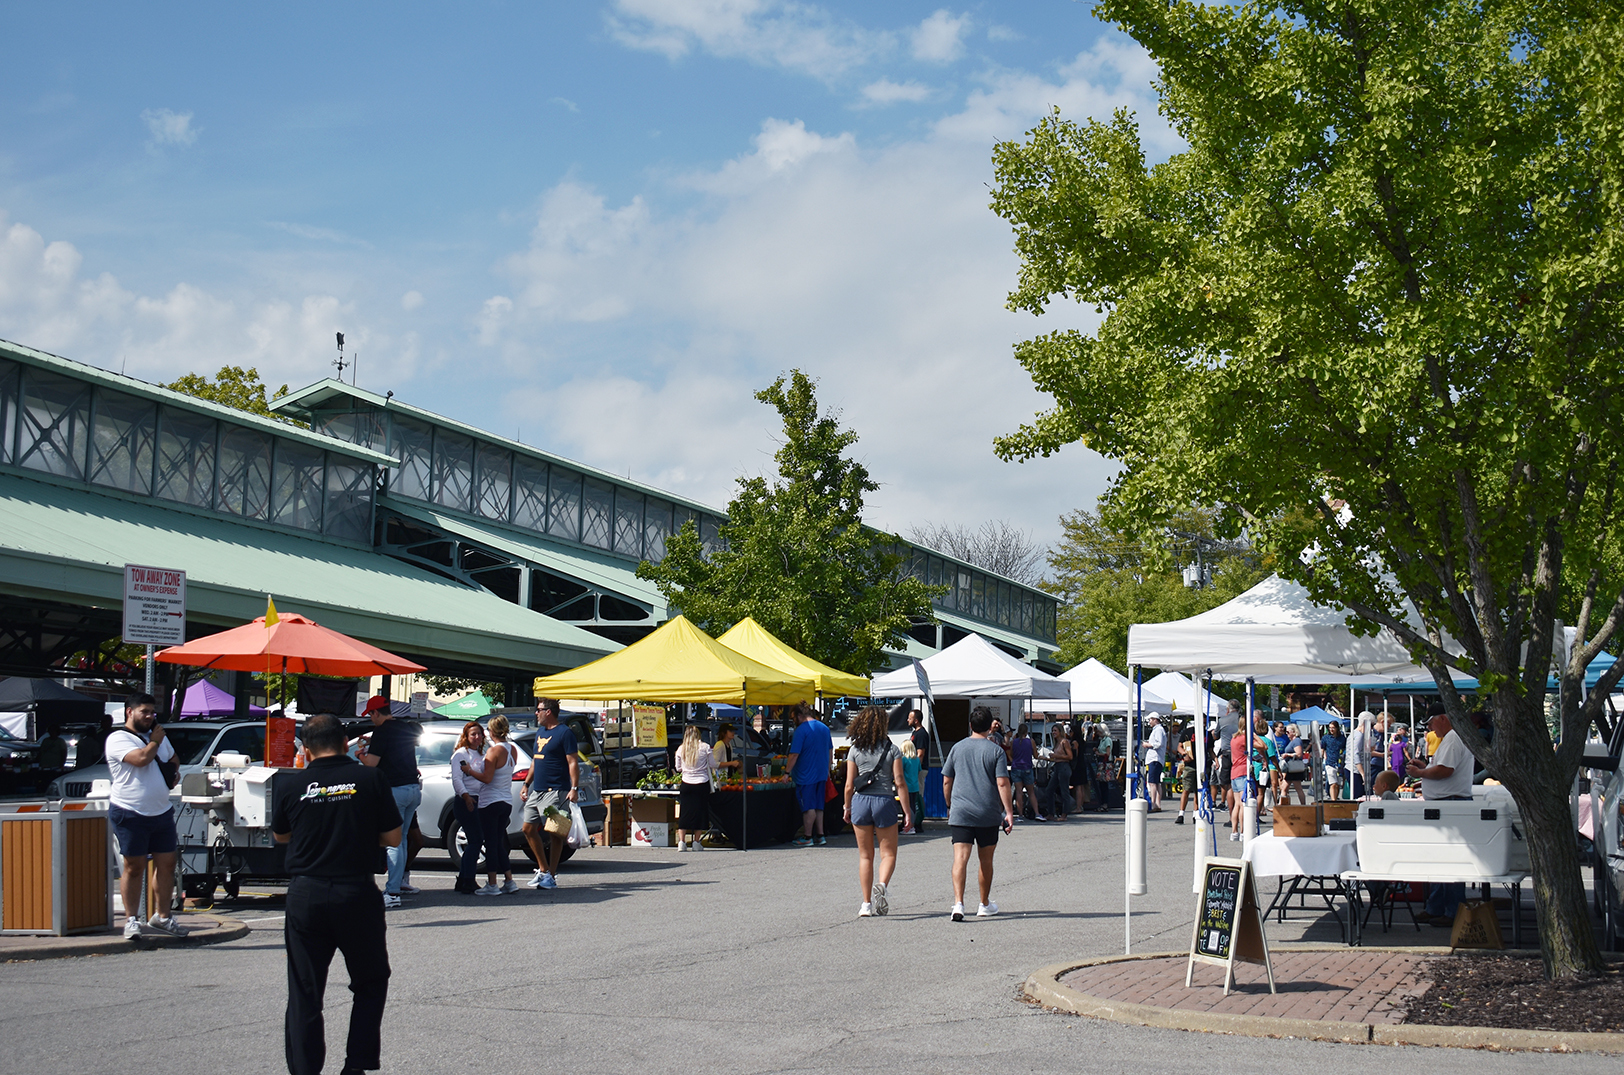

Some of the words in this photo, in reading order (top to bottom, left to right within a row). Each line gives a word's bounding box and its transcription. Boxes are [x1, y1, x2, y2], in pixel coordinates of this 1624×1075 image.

[132, 568, 146, 582] TOW
[146, 570, 163, 584] AWAY
[164, 572, 180, 586] ZONE
[140, 584, 159, 593] OWNER'S
[160, 586, 177, 595] EXPENSE
[300, 782, 356, 801] Lemongrass
[1212, 871, 1235, 890] VOTE
[1211, 908, 1224, 919] BEST
